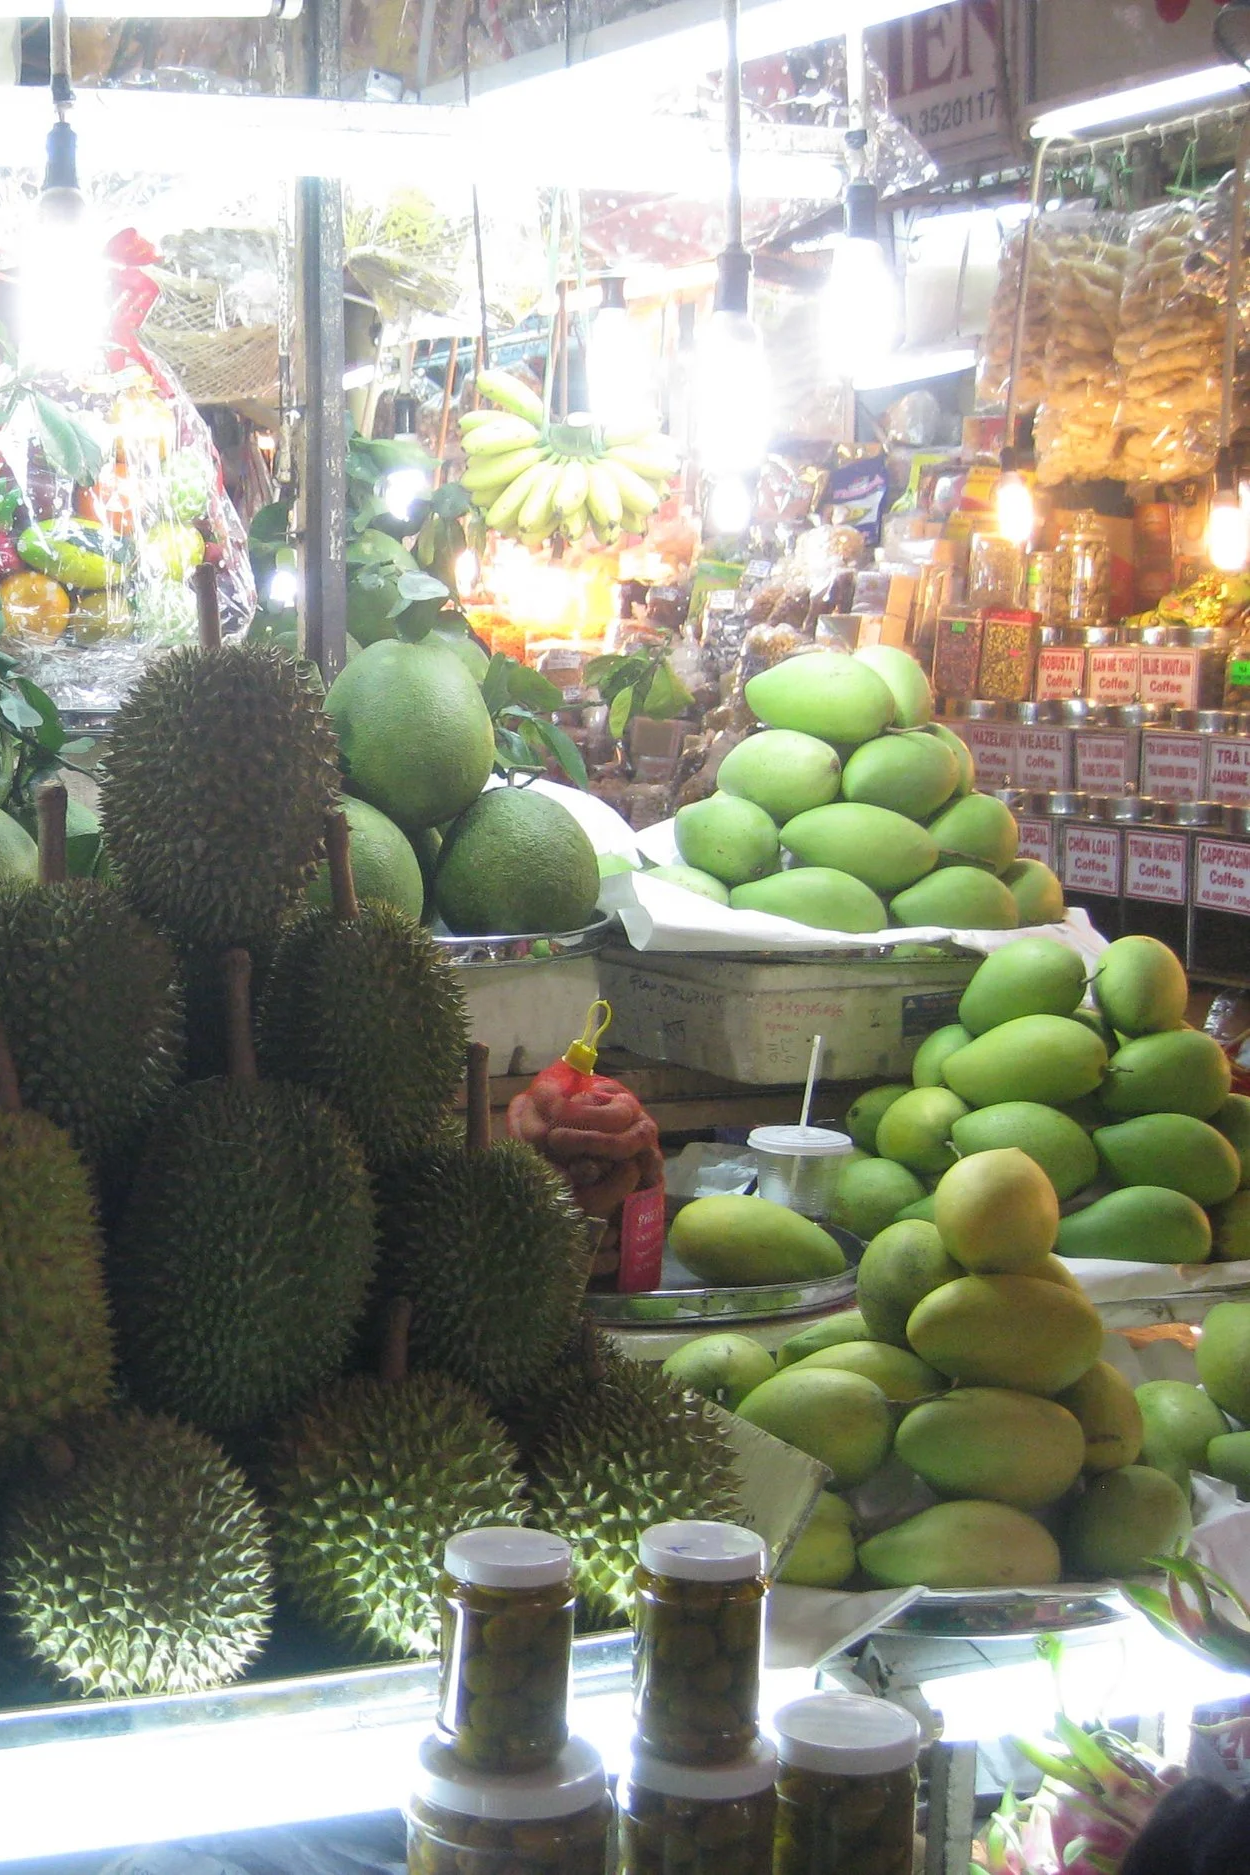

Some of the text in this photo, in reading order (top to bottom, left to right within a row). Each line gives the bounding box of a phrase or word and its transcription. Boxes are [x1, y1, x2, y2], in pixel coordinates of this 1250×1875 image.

[918, 87, 996, 137] 3520117
[1142, 658, 1159, 675] BLUE
[1045, 674, 1073, 688] Coffee
[1099, 677, 1129, 690] Coffee
[1150, 680, 1183, 694] Coffee
[1017, 731, 1062, 751] WEASEL
[978, 751, 1007, 766] Coffee
[1025, 754, 1055, 769] Coffee
[1212, 769, 1248, 786] JASMINE
[1075, 857, 1108, 873] Coffee
[1139, 863, 1172, 880] Coffee
[1210, 869, 1245, 889] Coffee
